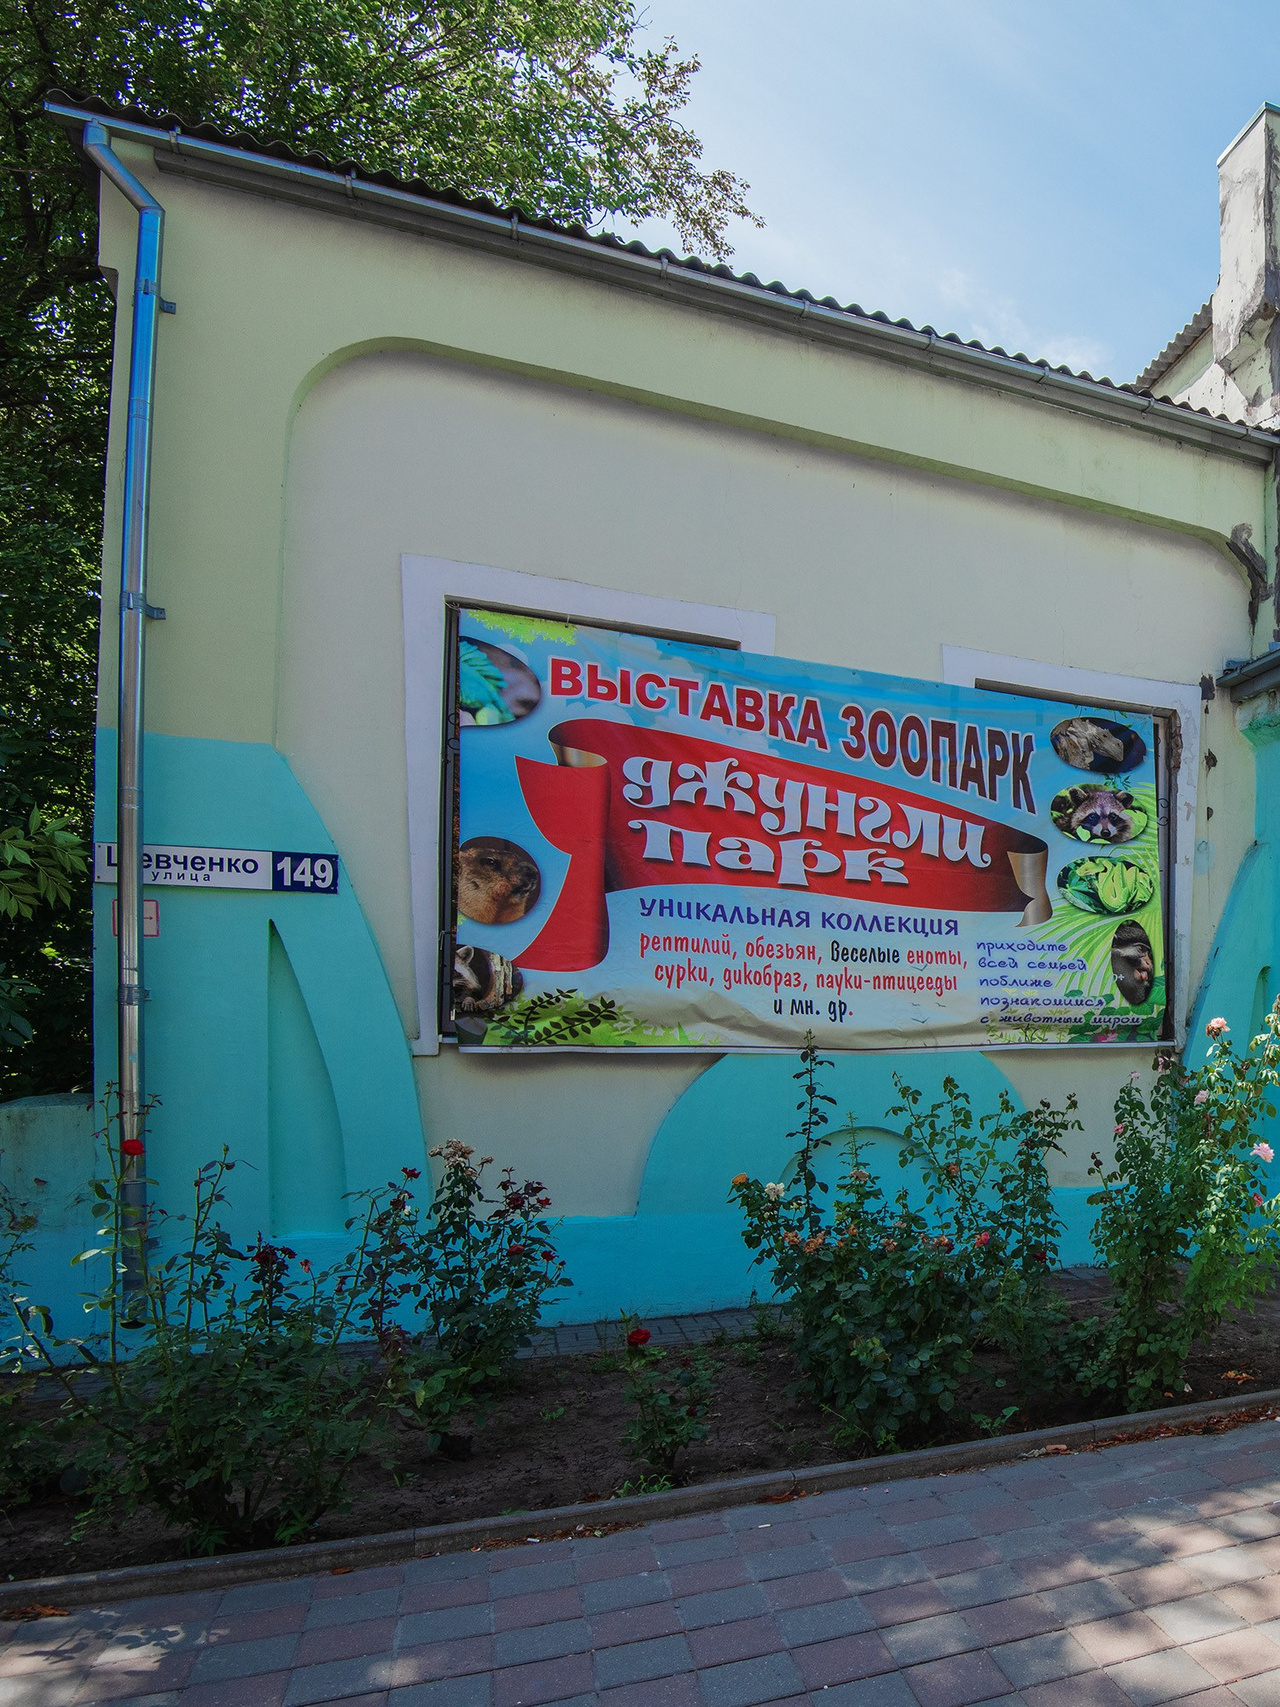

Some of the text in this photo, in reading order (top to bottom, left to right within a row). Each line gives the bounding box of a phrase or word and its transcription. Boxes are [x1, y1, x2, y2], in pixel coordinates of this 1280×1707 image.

[550, 657, 1037, 815] ВЫСТАВКА ЗООПАРК
[106, 846, 334, 888] евченко 149
[151, 871, 211, 882] улица
[639, 897, 959, 938] УНИКАЛЬНАЯ КОЛЛЕКЦИЯ
[639, 932, 737, 960] рептилий,
[745, 935, 823, 965] обезьян,
[906, 950, 968, 969] еноты,
[976, 940, 1068, 957] приходите
[978, 957, 1087, 972] всей семьей
[654, 957, 957, 997] сурки, дикобраз, пауки-птицееды
[979, 975, 1053, 987] поближе
[773, 998, 854, 1023] и мн. др.
[980, 997, 1104, 1012] познакомимся
[980, 1013, 1141, 1028] с животным миром
